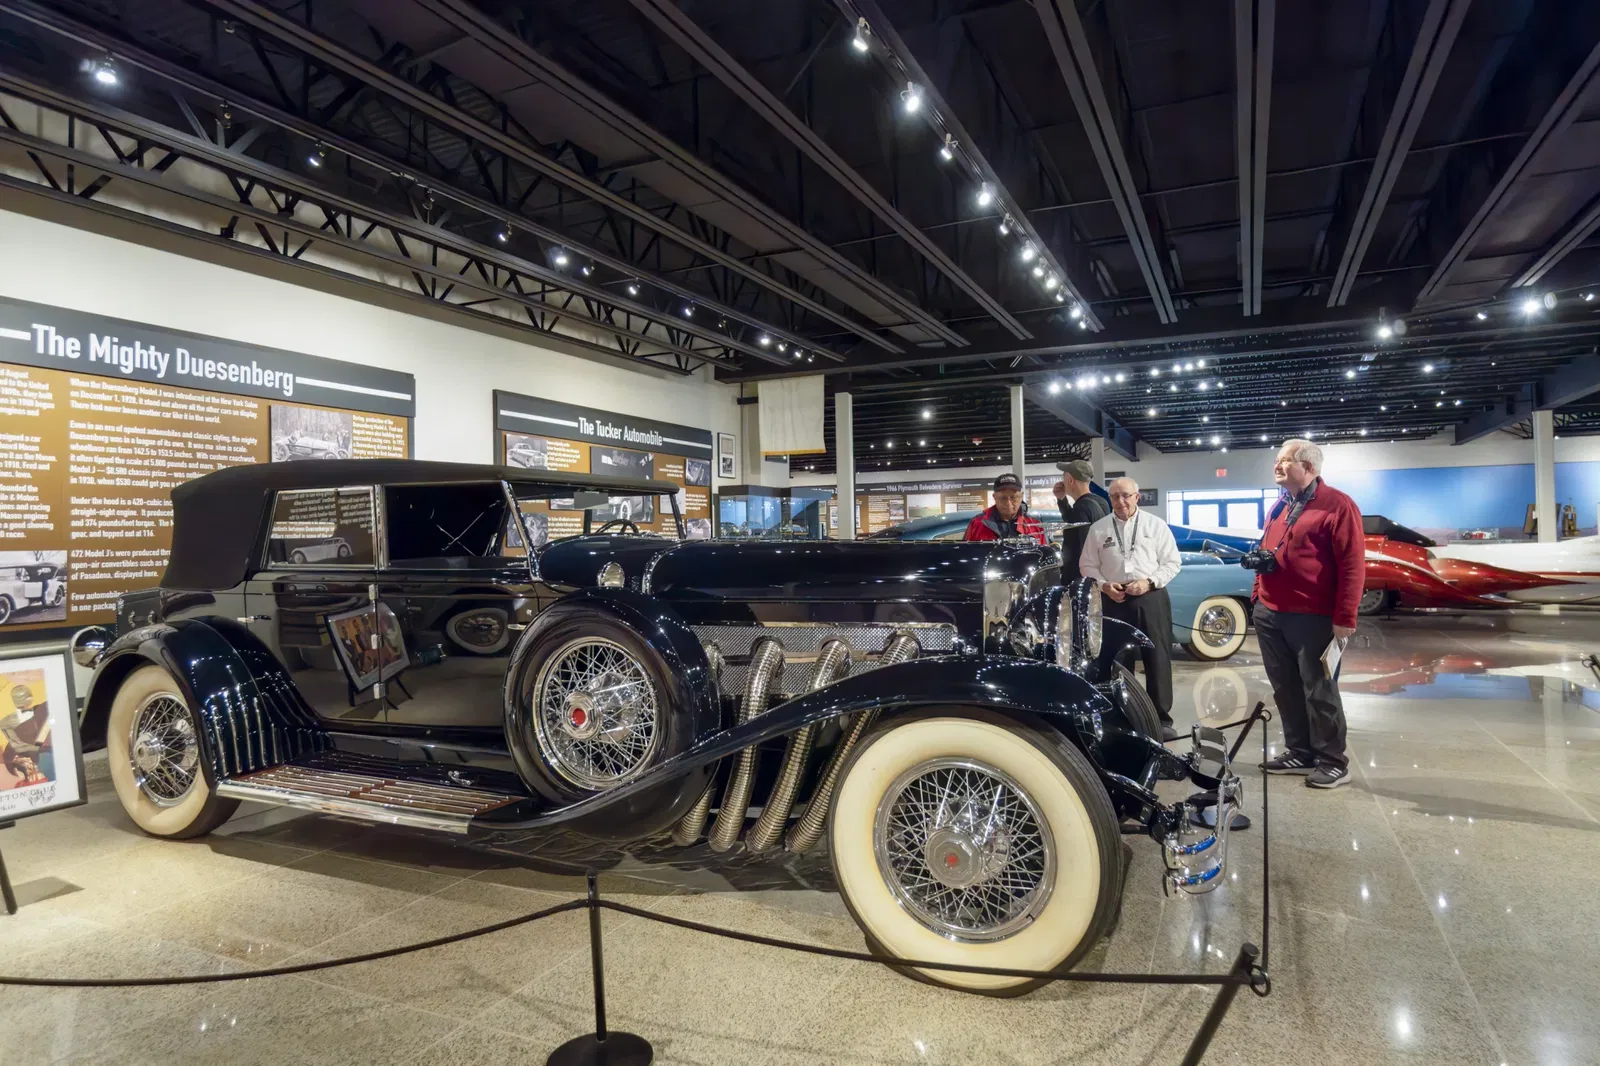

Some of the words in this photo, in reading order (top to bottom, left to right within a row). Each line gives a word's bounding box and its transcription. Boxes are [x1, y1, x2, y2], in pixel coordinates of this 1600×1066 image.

[31, 323, 81, 360] The
[89, 333, 170, 378] Mighty
[176, 348, 294, 397] Duesenberg
[578, 417, 594, 435] The
[596, 420, 622, 439] Tucker
[624, 426, 663, 446] Automobile
[1030, 478, 1049, 486] Landy's
